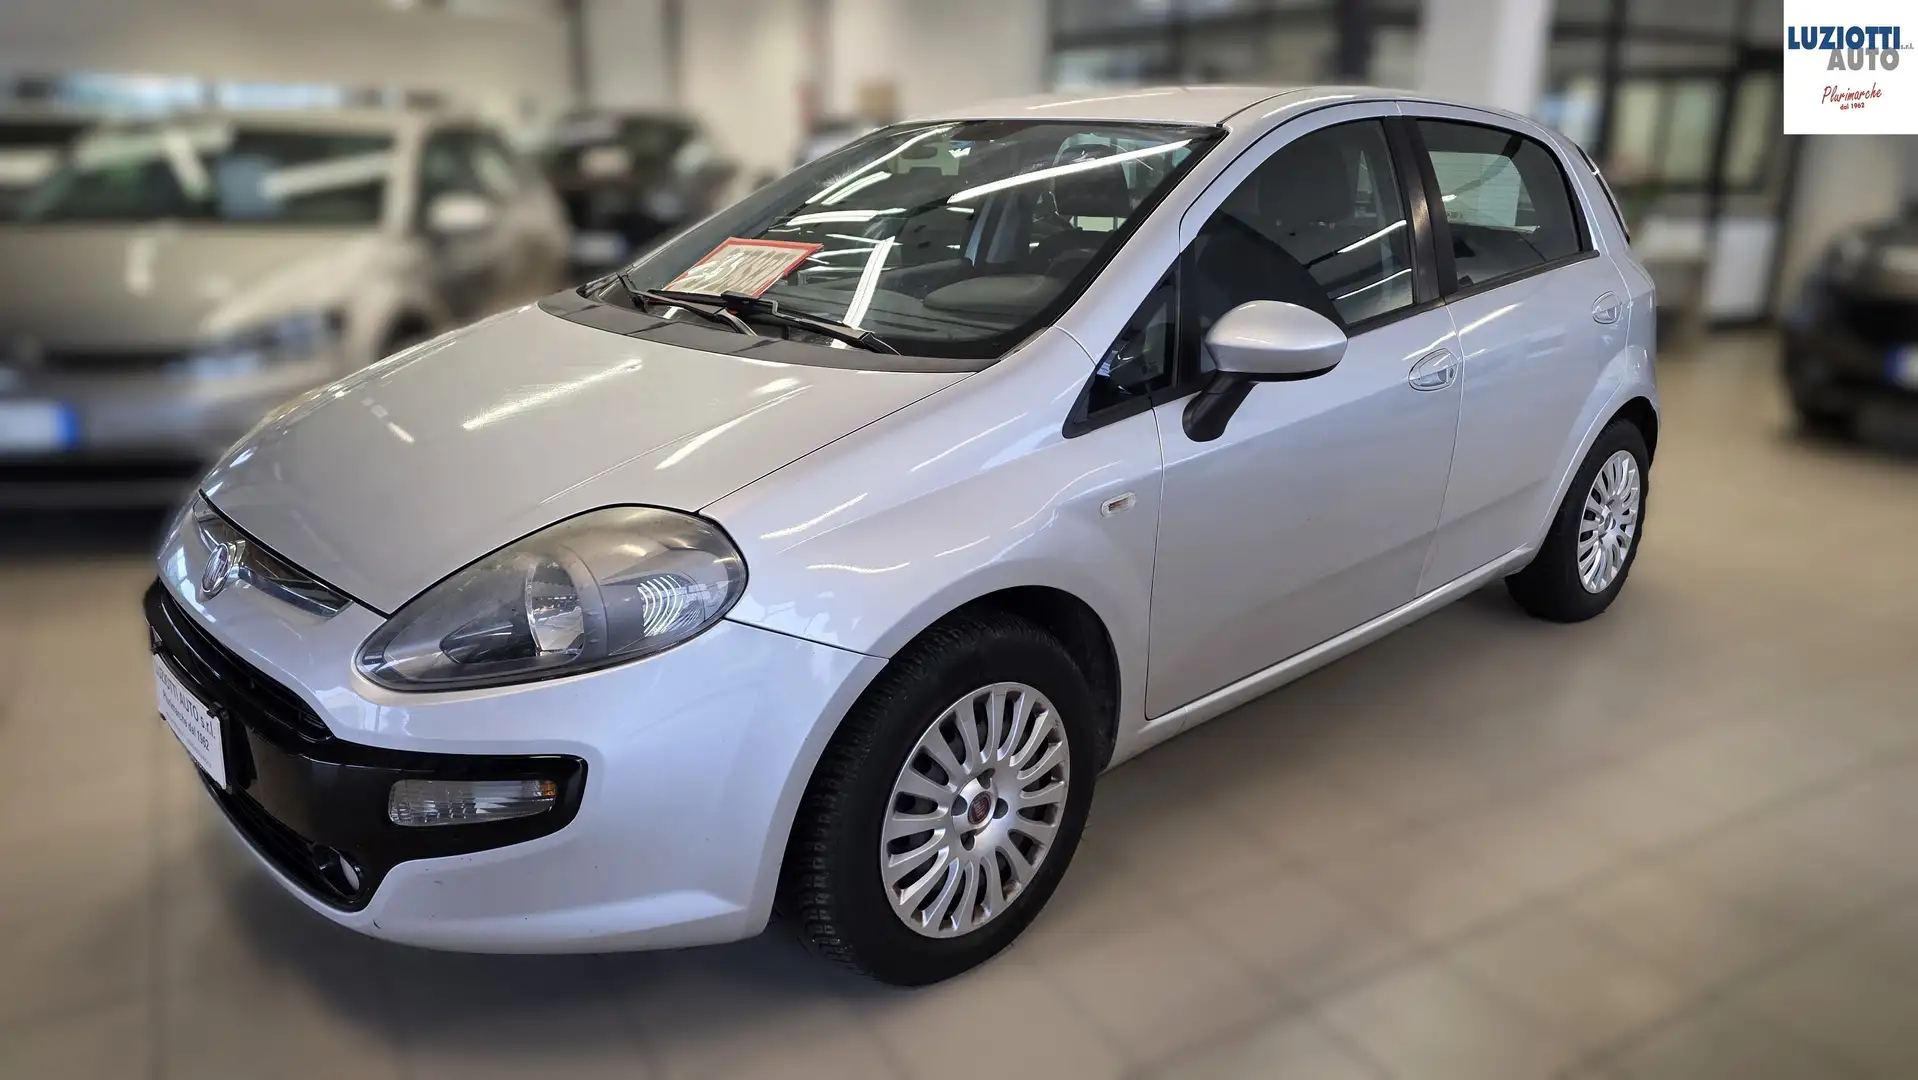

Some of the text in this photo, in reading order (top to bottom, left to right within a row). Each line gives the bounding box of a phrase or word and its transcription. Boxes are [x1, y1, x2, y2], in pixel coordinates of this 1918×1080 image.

[179, 691, 199, 720] AUTO
[200, 716, 216, 739] s.r.l.
[188, 722, 197, 738] dal
[196, 730, 210, 752] 1962
